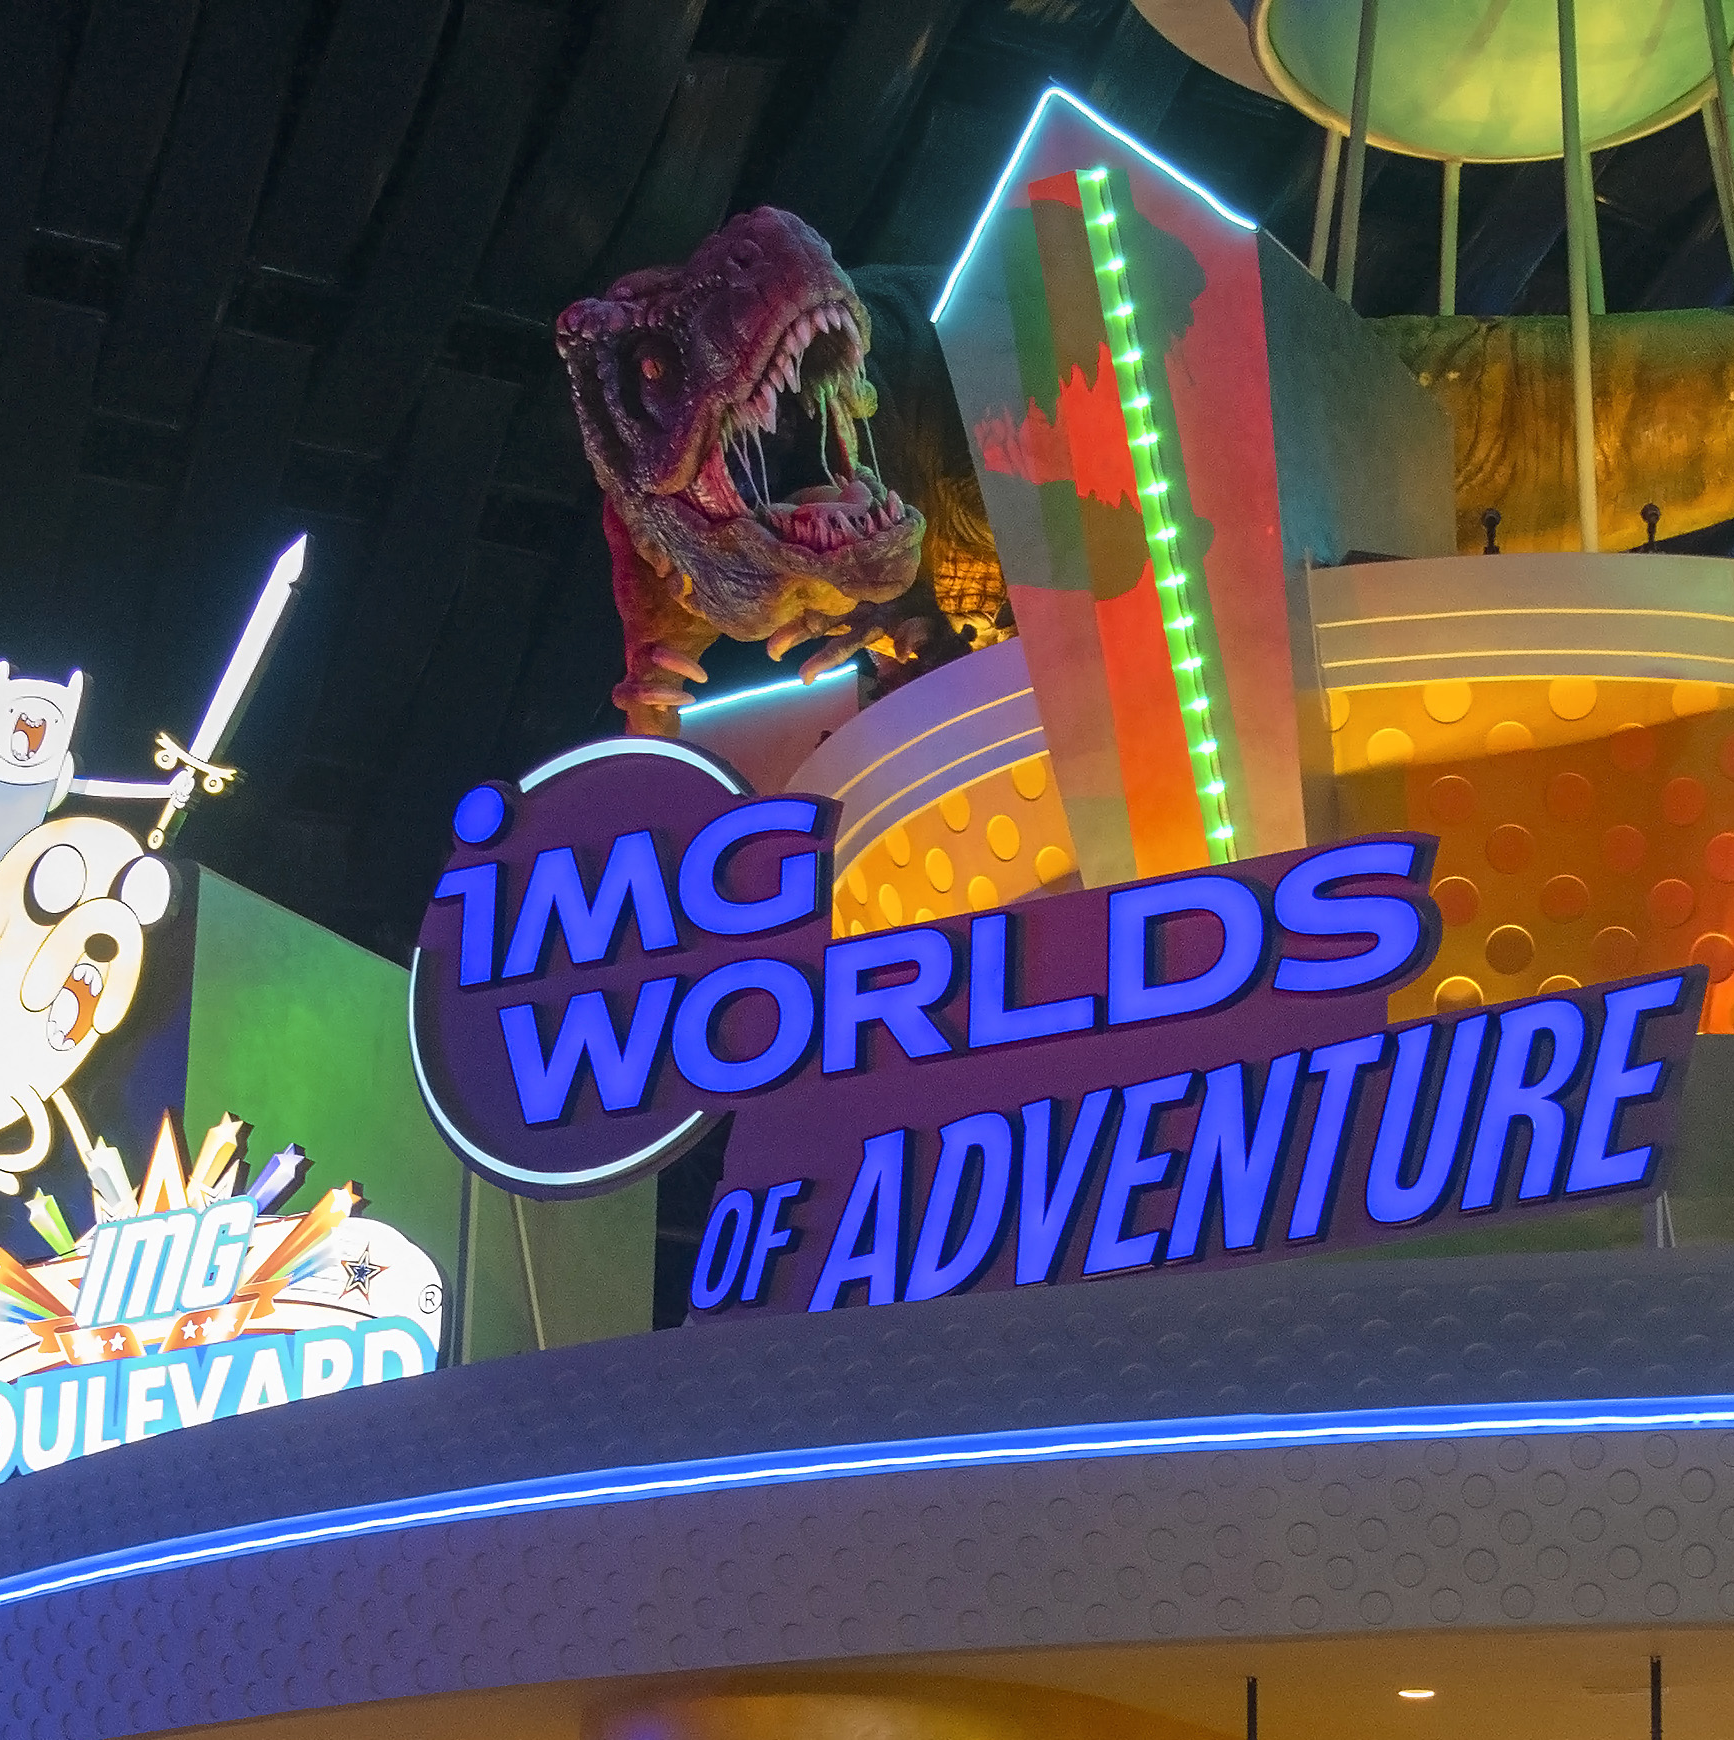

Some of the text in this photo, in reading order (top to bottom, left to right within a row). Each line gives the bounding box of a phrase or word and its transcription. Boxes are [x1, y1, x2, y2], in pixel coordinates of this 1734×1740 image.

[498, 840, 1428, 1129] WORLDS
[73, 1194, 259, 1328] IMG
[689, 973, 1686, 1315] OF ADVENTURE
